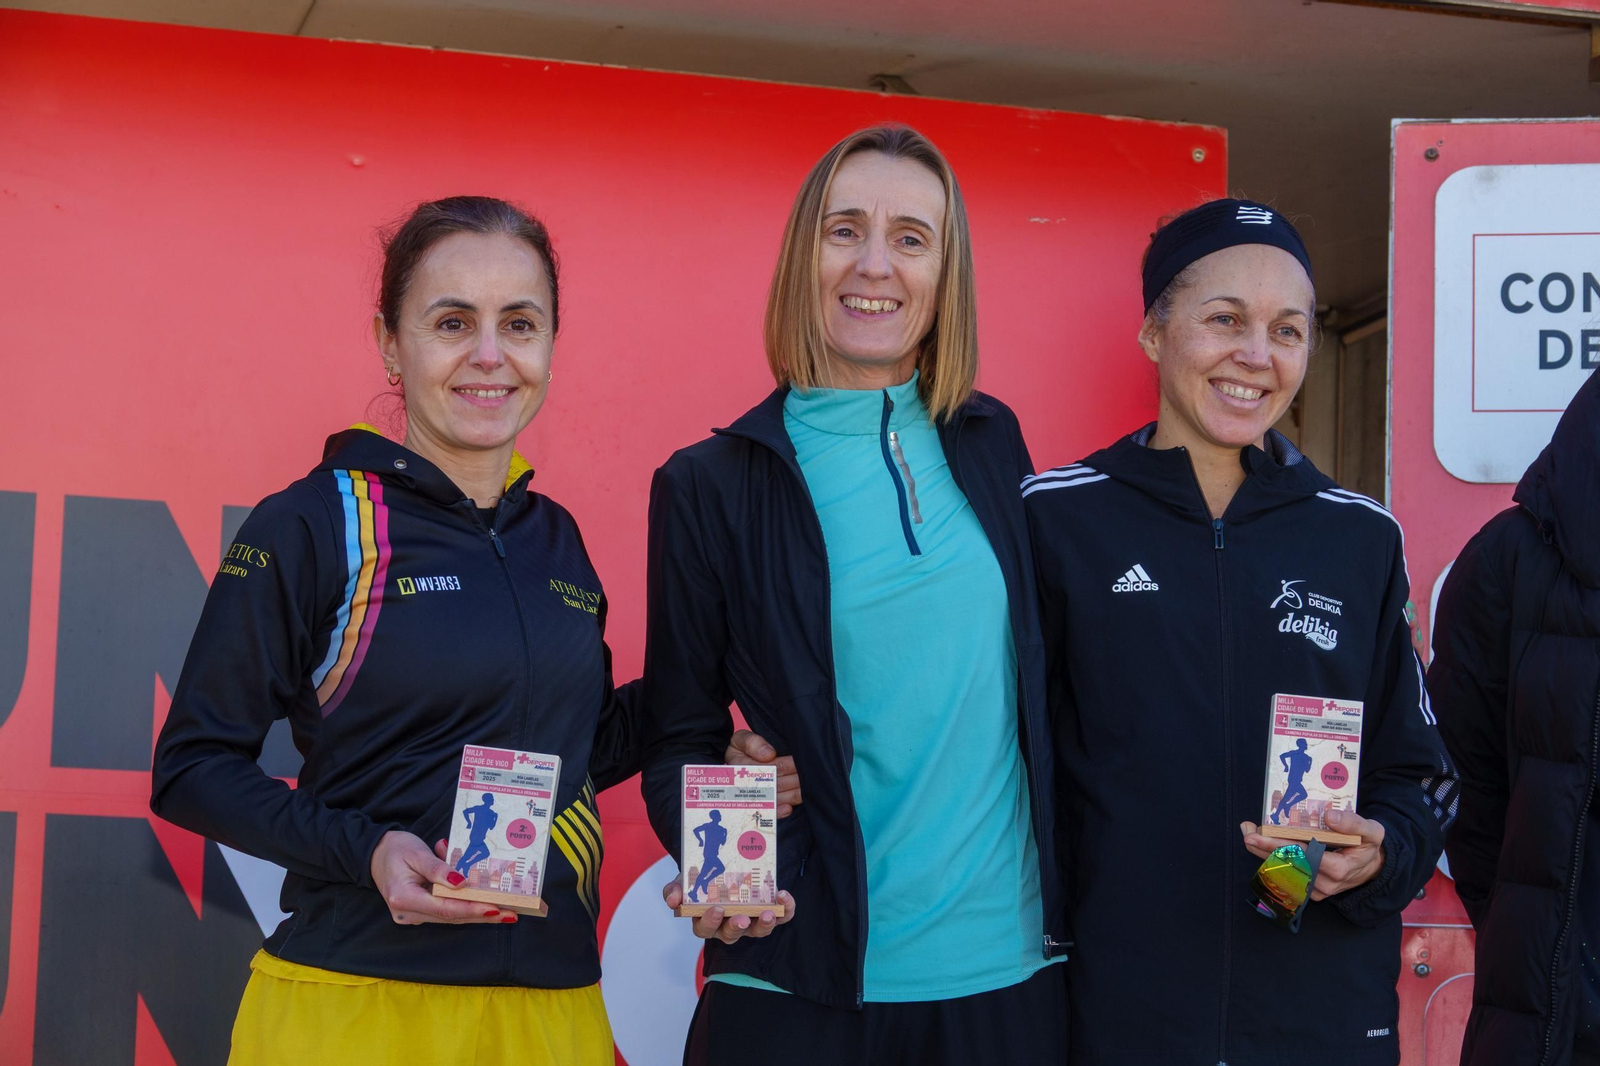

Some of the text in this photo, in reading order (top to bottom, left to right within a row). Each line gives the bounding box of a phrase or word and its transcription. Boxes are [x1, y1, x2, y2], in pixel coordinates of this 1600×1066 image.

[220, 561, 248, 578] Lázaro
[414, 576, 461, 591] INVERSE
[1112, 581, 1159, 592] adidas
[563, 595, 581, 609] San
[1308, 597, 1341, 616] DELIKIA
[1278, 612, 1338, 643] delikia
[1278, 697, 1294, 705] MILLA
[1277, 704, 1296, 712] CIDADE
[466, 748, 483, 757] MILLA
[465, 756, 485, 765] CIDADE
[495, 760, 509, 768] VIGO
[510, 832, 532, 840] POSTO
